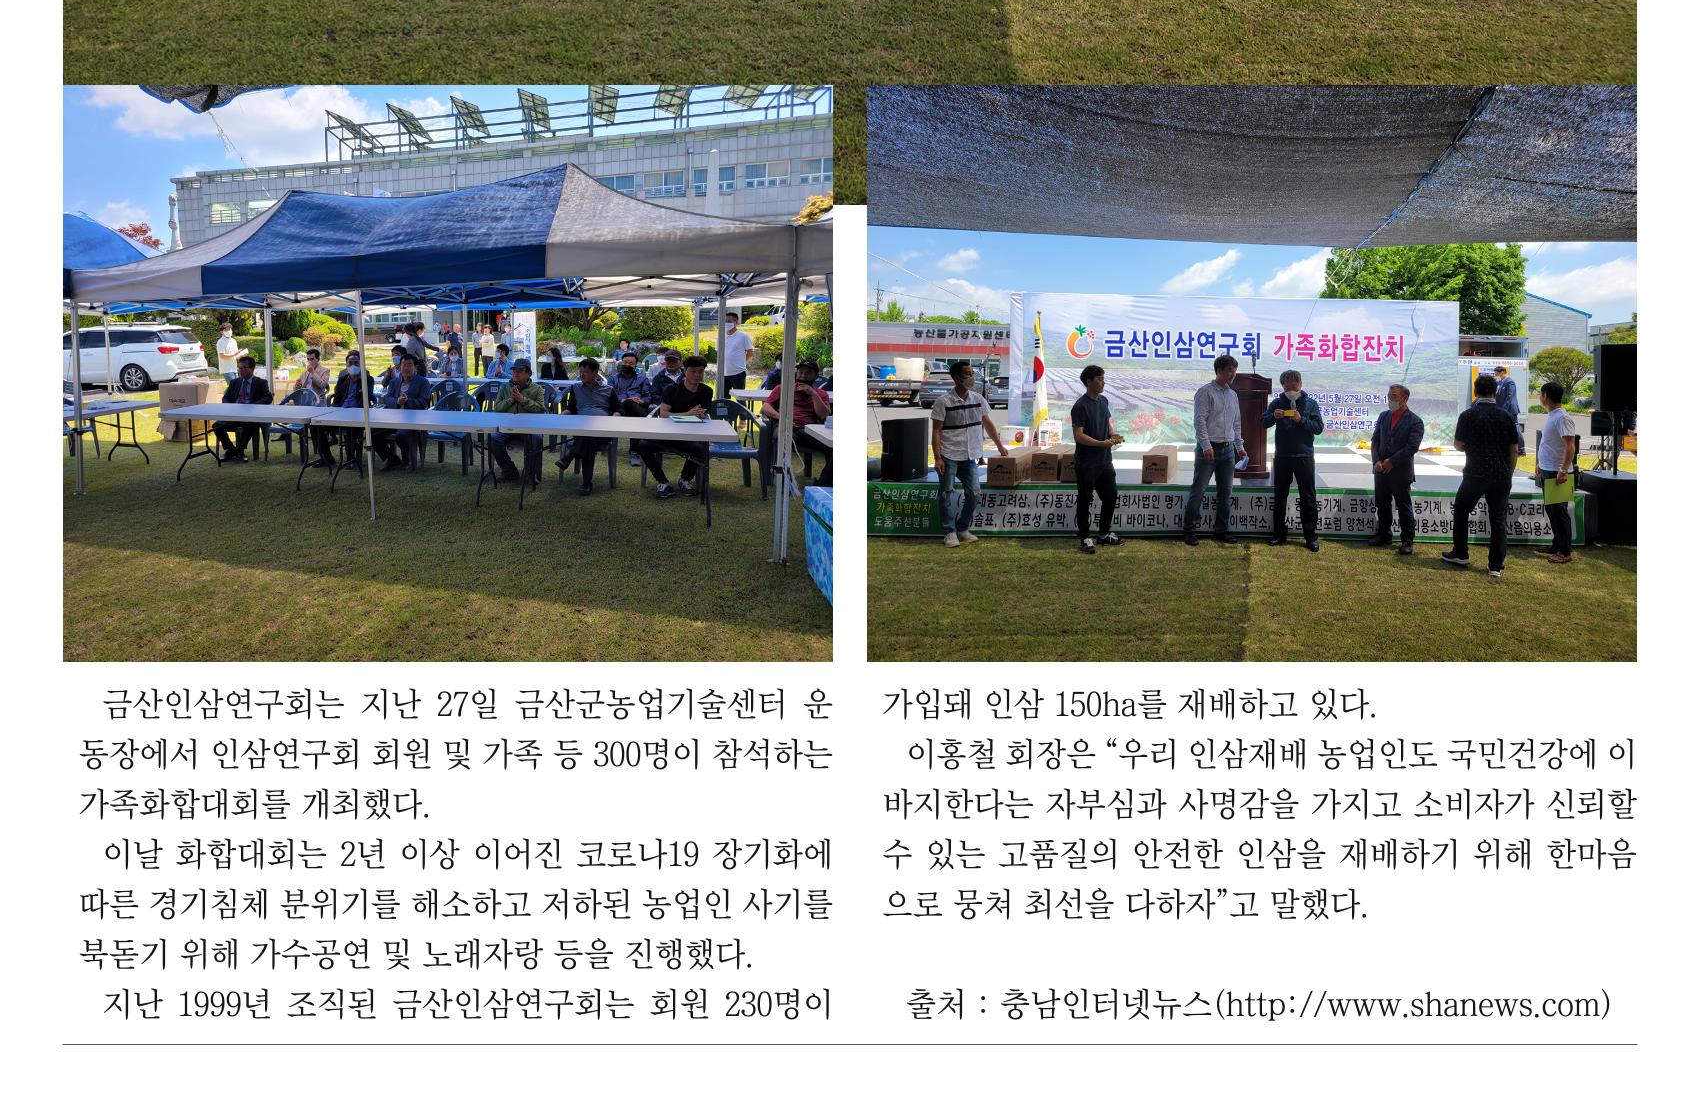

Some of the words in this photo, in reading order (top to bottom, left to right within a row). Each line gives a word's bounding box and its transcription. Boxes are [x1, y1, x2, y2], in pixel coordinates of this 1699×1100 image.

[1104, 330, 1261, 361] 금산인삼연구회
[1273, 331, 1405, 363] 가족화합잔치
[1328, 393, 1342, 404] 5월
[1344, 394, 1362, 403] 27일
[1364, 394, 1380, 403] 오전
[873, 488, 938, 501] 금산인삼연구회
[876, 502, 932, 514] 가족화합잔치
[874, 516, 930, 528] 도움주신분들
[1002, 513, 1042, 528] (주)효성
[1046, 513, 1069, 528] 유박,
[1126, 513, 1169, 529] 바이코나,
[103, 687, 345, 721] 금산인삼연구회는
[361, 687, 422, 721] 지난
[437, 687, 498, 720] 27일
[515, 687, 784, 721] 금산군농업기술센터
[803, 688, 833, 720] 운
[883, 687, 971, 721] 가입돼
[986, 687, 1045, 721] 인삼
[1056, 689, 1167, 720] 150ha를
[1177, 687, 1298, 721] 재배하고
[1311, 687, 1376, 721] 있다.
[79, 737, 197, 771] 동장에서
[213, 737, 358, 771] 인삼연구회
[372, 737, 432, 770] 회원
[443, 737, 471, 771] 및
[483, 737, 543, 771] 가족
[553, 739, 583, 771] 등
[593, 738, 699, 771] 300명이
[713, 737, 833, 771] 참석하는
[908, 737, 996, 771] 이홍철
[1006, 737, 1096, 771] 회장은
[1106, 737, 1175, 771] “우리
[1190, 737, 1306, 771] 인삼재배
[1317, 737, 1438, 771] 농업인도
[1447, 737, 1595, 771] 국민건강에
[1609, 738, 1634, 770] 이
[79, 787, 291, 821] 가족화합대회를
[302, 787, 429, 821] 개최했다.
[883, 787, 1034, 821] 바지한다는
[1046, 787, 1168, 821] 자부심과
[1178, 787, 1299, 821] 사명감을
[1311, 787, 1402, 821] 가지고
[1413, 787, 1535, 821] 소비자가
[1547, 787, 1638, 821] 신뢰할
[105, 837, 164, 871] 이날
[175, 837, 327, 871] 화합대회는
[340, 837, 385, 870] 2년
[401, 837, 461, 871] 이상
[475, 837, 563, 870] 이어진
[576, 837, 699, 871] 코로나19
[712, 837, 831, 871] 장기화에
[882, 838, 913, 871] 수
[928, 837, 986, 871] 있는
[998, 837, 1116, 871] 고품질의
[1134, 837, 1224, 870] 안전한
[1238, 837, 1326, 871] 인삼을
[1339, 837, 1457, 871] 재배하기
[1473, 837, 1531, 871] 위해
[1547, 837, 1637, 871] 한마음
[79, 887, 139, 921] 따른
[150, 887, 267, 921] 경기침체
[280, 887, 401, 921] 분위기를
[412, 887, 532, 921] 해소하고
[542, 887, 632, 921] 저하된
[642, 887, 732, 921] 농업인
[742, 887, 833, 921] 사기를
[883, 890, 943, 918] 으로
[954, 887, 1010, 921] 뭉쳐
[1024, 887, 1114, 920] 최선을
[1125, 887, 1259, 921] 다하자”고
[1270, 887, 1367, 921] 말했다.
[79, 937, 166, 971] 북돋기
[180, 937, 238, 971] 위해
[250, 937, 371, 971] 가수공연
[383, 937, 410, 971] 및
[422, 937, 544, 971] 노래자랑
[554, 937, 614, 971] 등을
[625, 937, 752, 971] 진행했다.
[103, 987, 164, 1021] 지난
[179, 987, 271, 1020] 1999년
[287, 987, 377, 1020] 조직된
[392, 987, 635, 1021] 금산인삼연구회는
[650, 987, 709, 1021] 회원
[725, 987, 830, 1021] 230명이
[906, 987, 963, 1021] 출처
[1000, 987, 1610, 1022] 충남인터넷뉴스(http://www.shanews.com)
